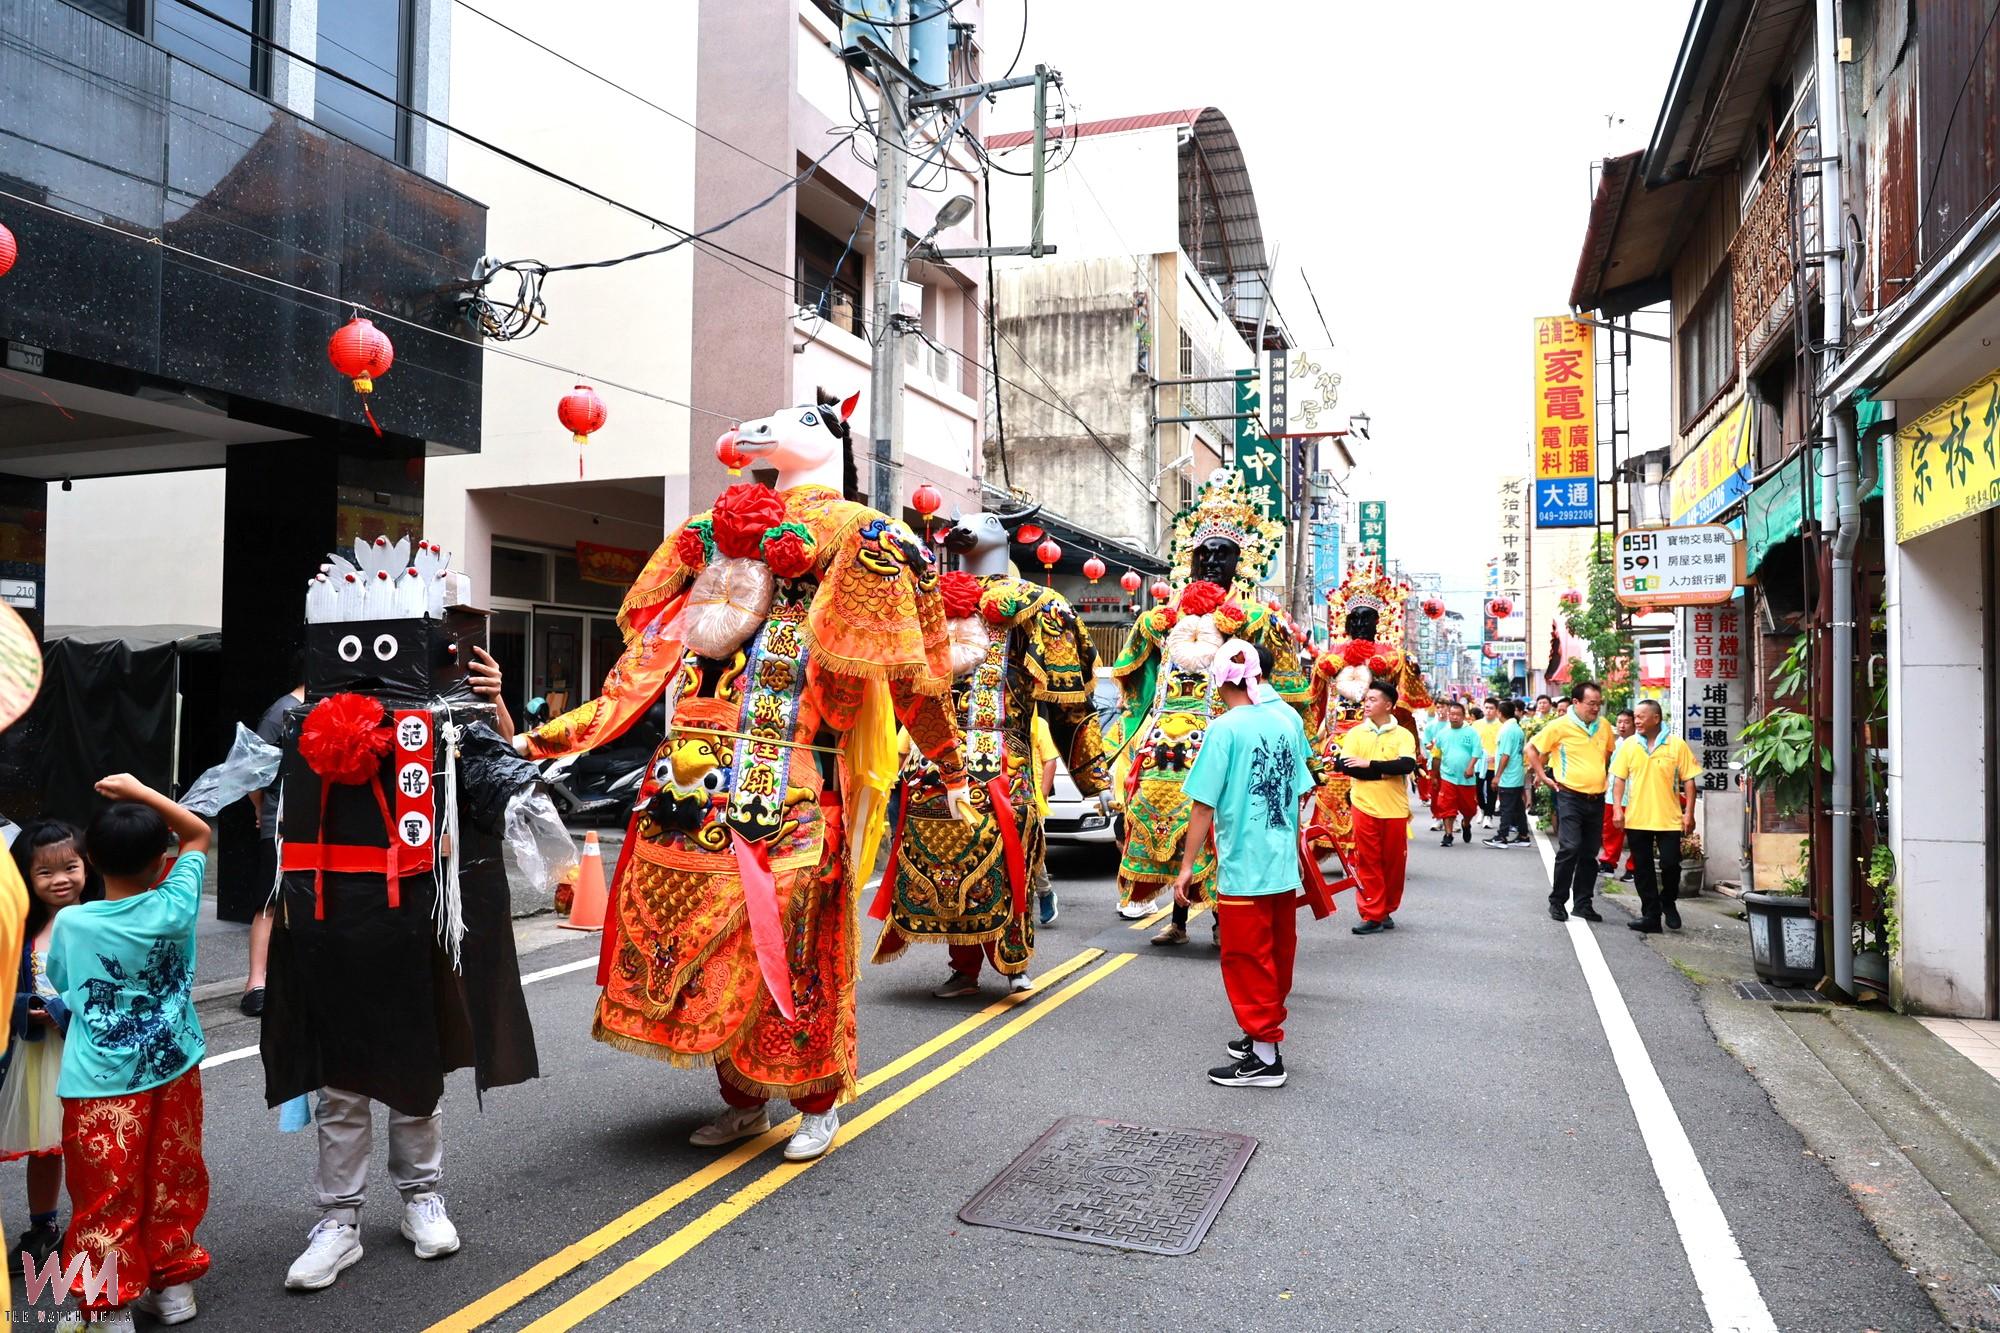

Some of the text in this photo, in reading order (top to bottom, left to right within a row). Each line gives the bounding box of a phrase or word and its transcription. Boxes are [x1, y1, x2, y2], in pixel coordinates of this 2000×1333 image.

[1543, 349, 1584, 420] 家電
[1542, 426, 1562, 474] 電料
[1569, 425, 1588, 473] 廣播
[1543, 483, 1588, 507] 大通
[1539, 510, 1593, 521] 049-2992206
[1623, 532, 1725, 551] 8591 寶物交易網
[1624, 553, 1726, 570] 591 房屋交易網
[1668, 574, 1727, 587] 人力銀行網
[1703, 683, 1728, 791] 埔里總經銷
